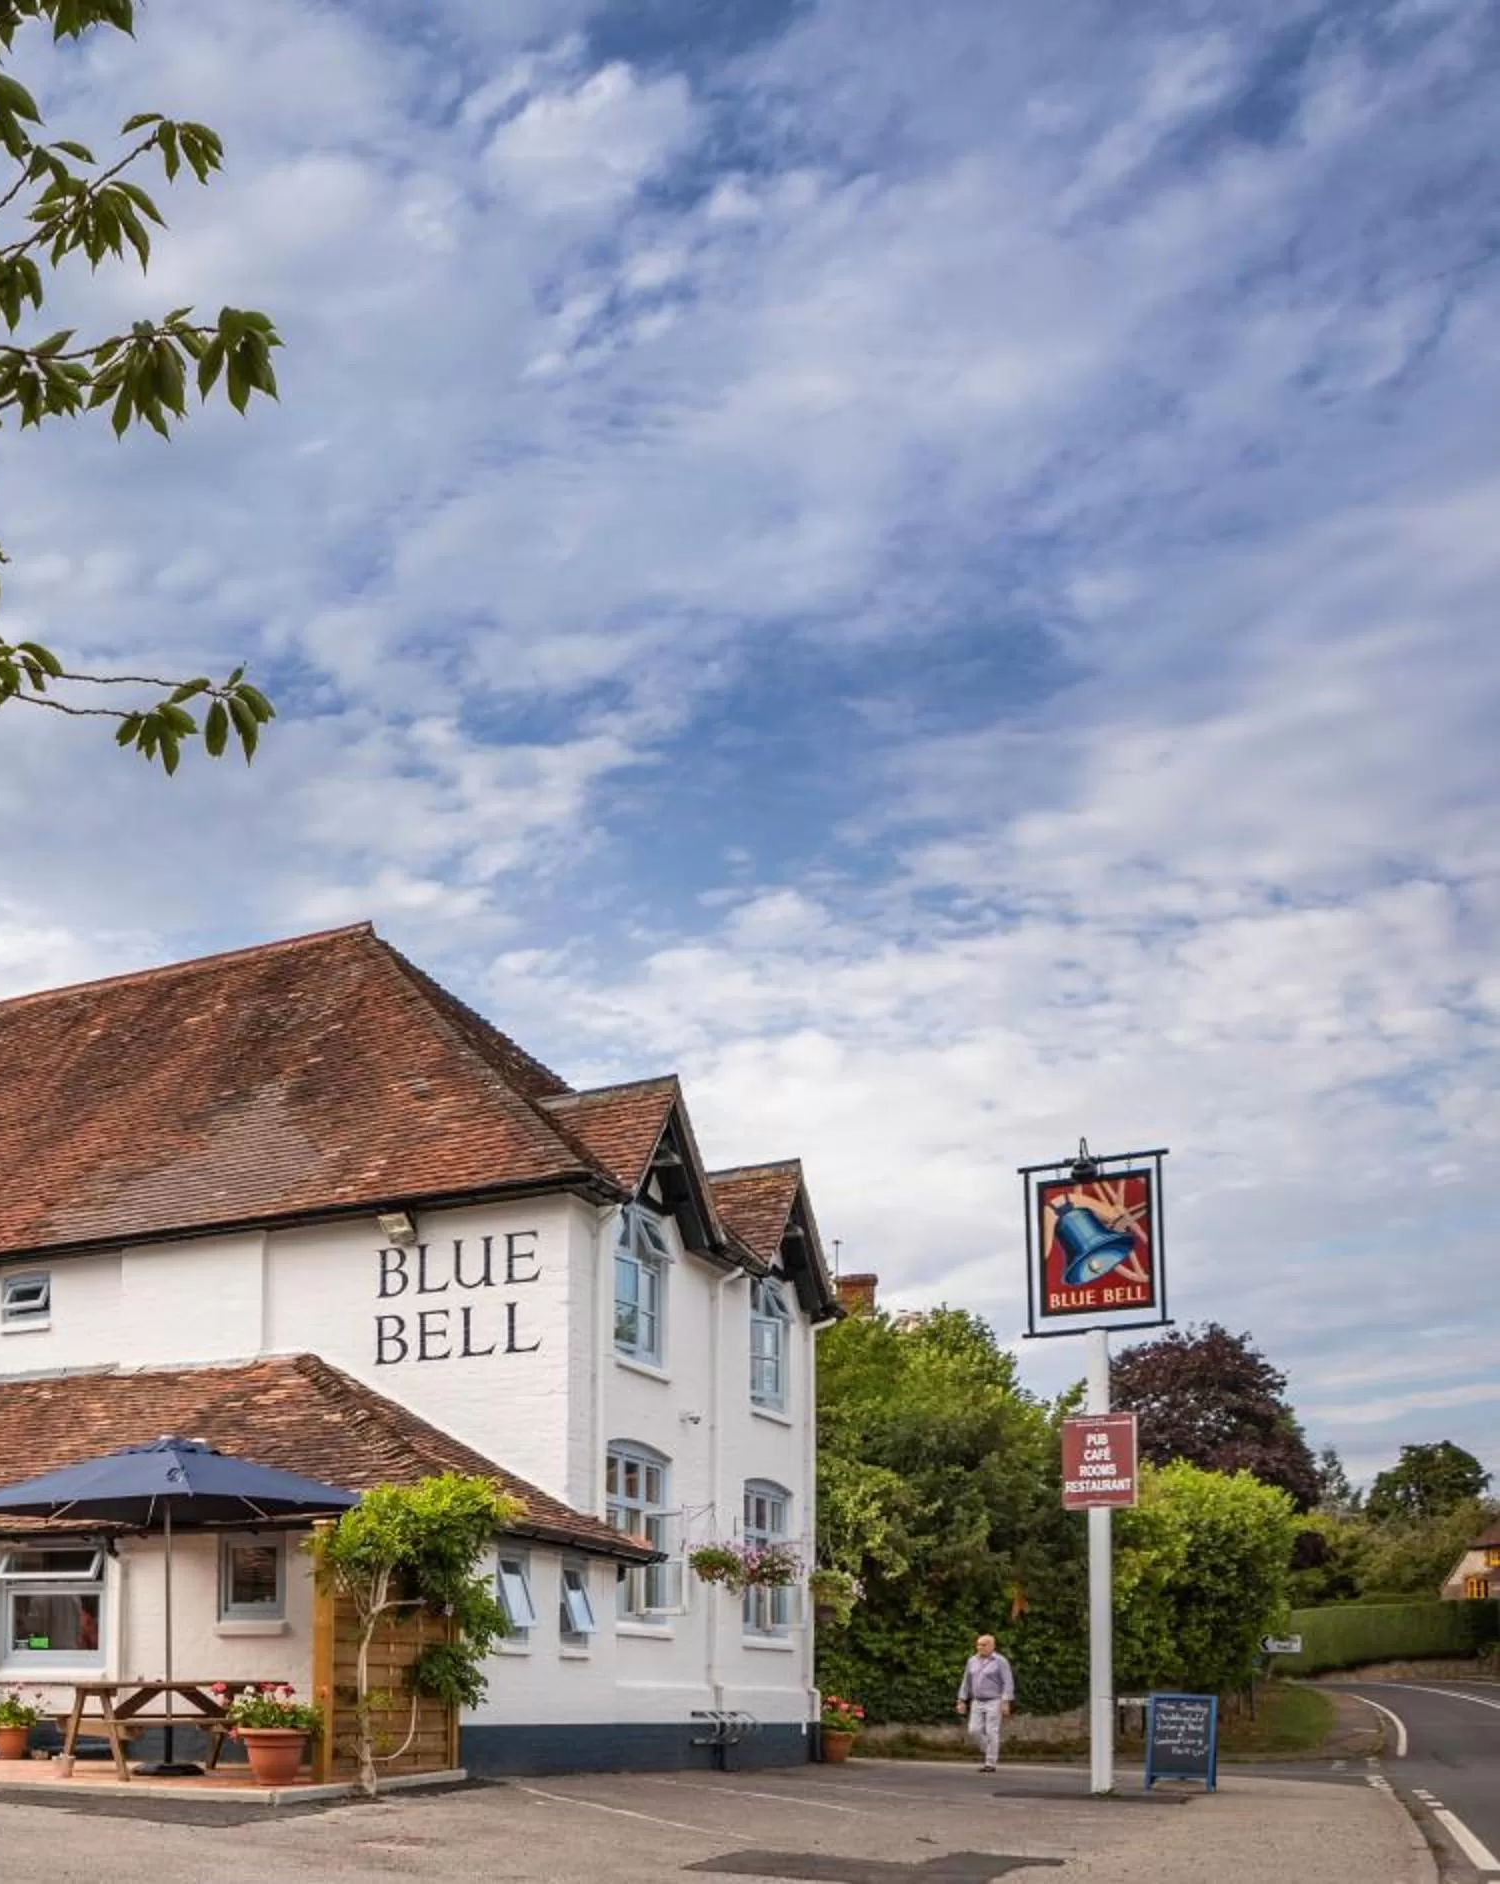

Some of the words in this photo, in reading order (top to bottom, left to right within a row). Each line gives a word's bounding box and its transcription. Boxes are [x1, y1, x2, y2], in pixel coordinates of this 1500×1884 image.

[374, 1230, 543, 1299] BLUE
[1049, 1289, 1097, 1309] BLUE
[1103, 1285, 1147, 1304] BELL
[374, 1302, 542, 1366] BELL
[1086, 1433, 1109, 1447] PUB
[1078, 1463, 1117, 1477] ROOMS
[1065, 1478, 1132, 1493] RESTAURANT
